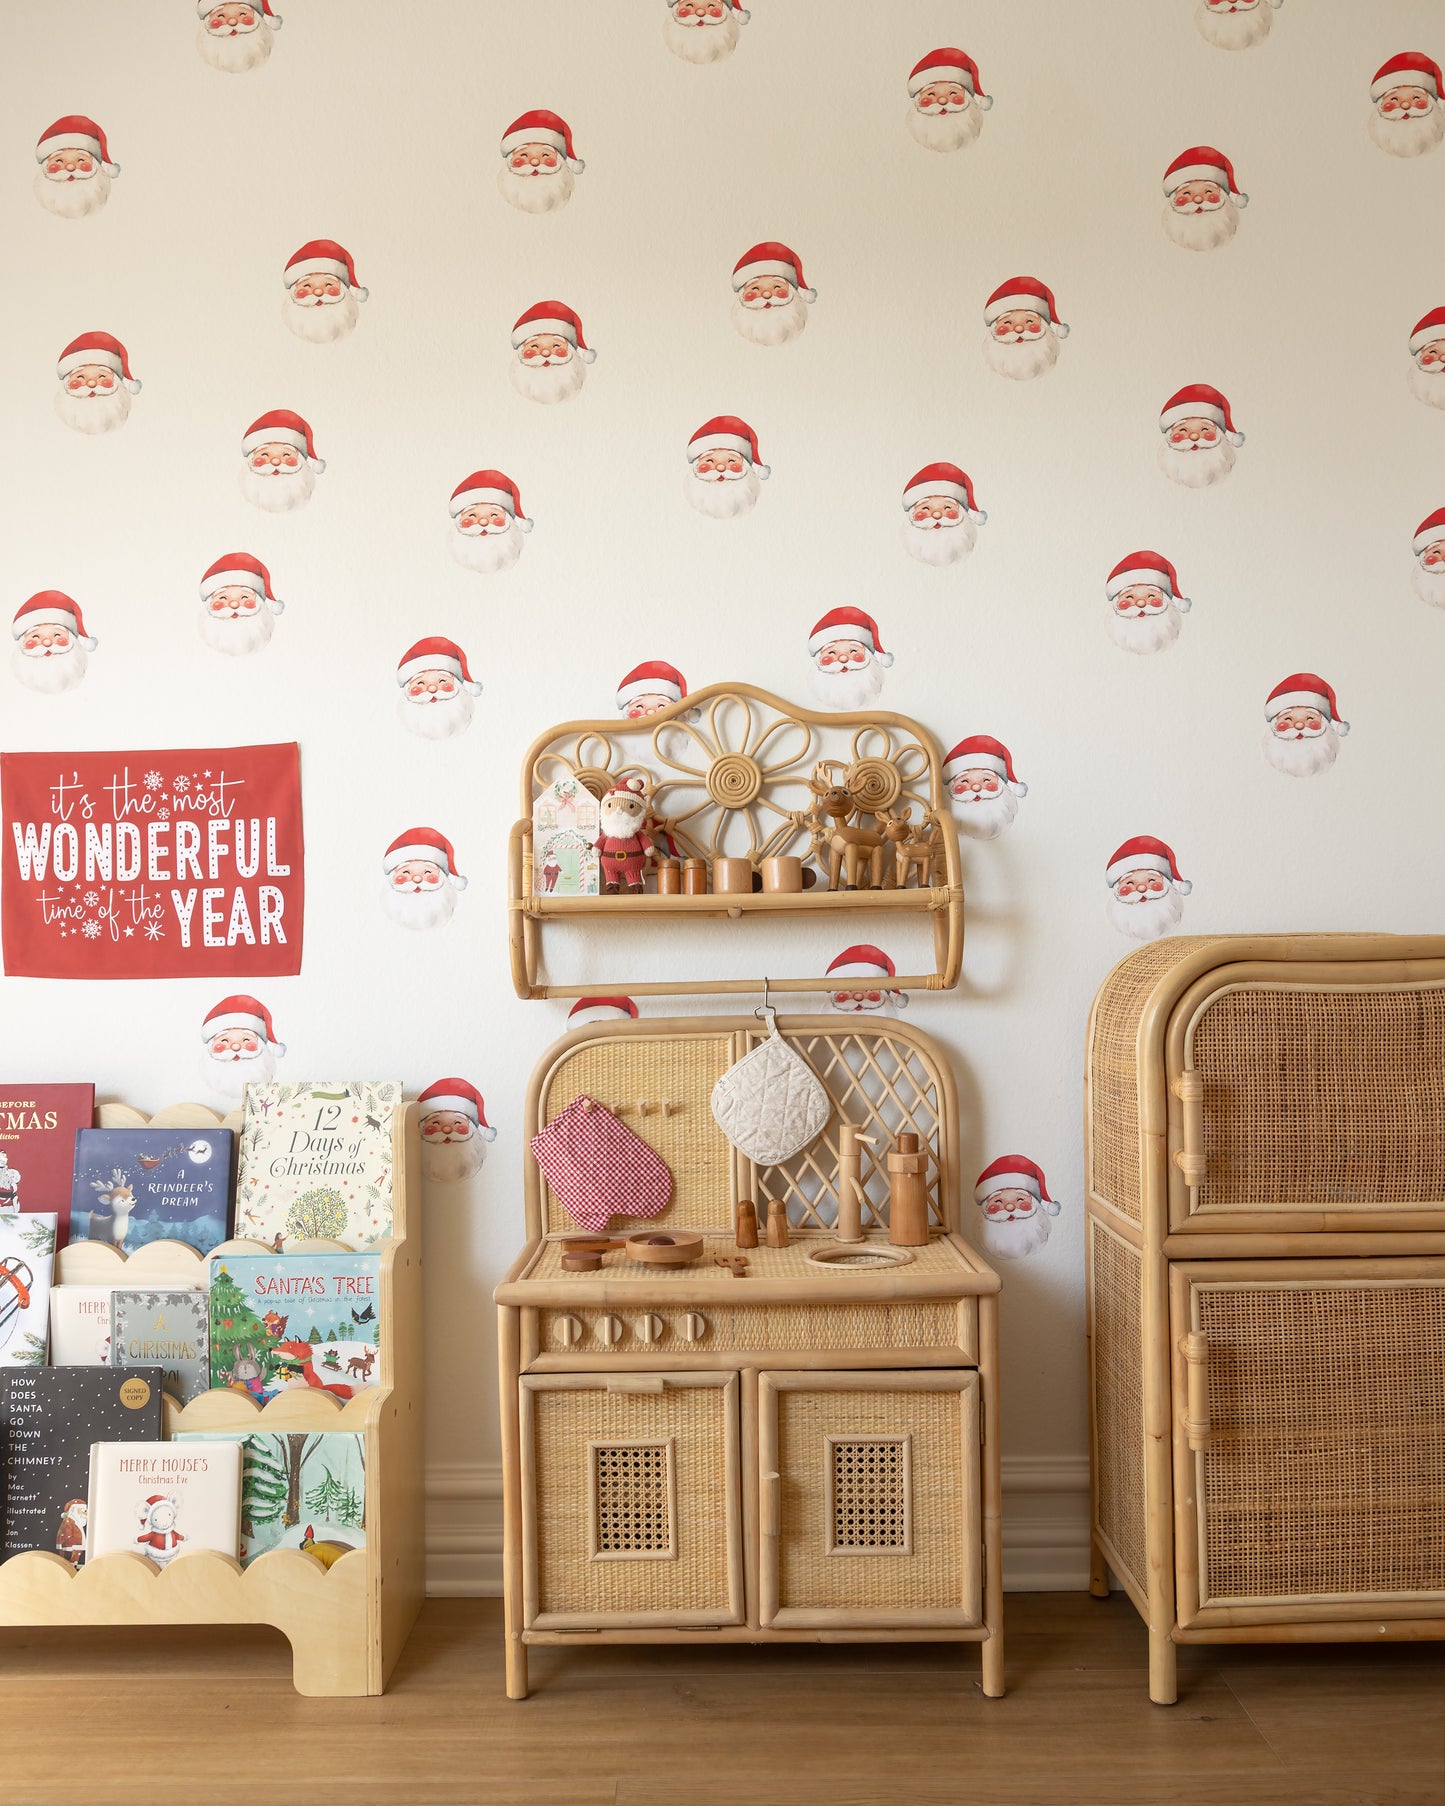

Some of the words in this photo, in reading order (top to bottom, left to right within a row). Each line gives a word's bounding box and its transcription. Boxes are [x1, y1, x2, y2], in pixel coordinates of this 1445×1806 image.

[50, 771, 96, 821] it's
[103, 766, 156, 821] the
[173, 771, 245, 818] most
[12, 817, 291, 882] WONDERFUL
[36, 889, 86, 924] time
[98, 888, 120, 942] of
[124, 884, 165, 924] the
[171, 886, 287, 947] YEAR
[0, 1101, 36, 1109] EFORE
[313, 1105, 342, 1131] 12
[288, 1130, 344, 1160] Days
[348, 1137, 366, 1159] of
[269, 1156, 366, 1178] Christmas
[177, 1169, 185, 1179] A
[148, 1180, 214, 1194] REINDEER'S
[161, 1197, 199, 1207] DREAM
[254, 1275, 326, 1295] SANTA'S
[332, 1276, 375, 1295] TREE
[152, 1312, 169, 1331] A
[129, 1340, 197, 1360] CHRISTMAS
[11, 1378, 36, 1387] HOW
[10, 1391, 37, 1400] DOES
[10, 1404, 43, 1413] SANTA
[9, 1417, 24, 1426] GO
[9, 1430, 41, 1438] DOWN
[9, 1443, 28, 1452] THE
[7, 1456, 63, 1466] CHIMNEY?
[119, 1459, 157, 1472] MERRY
[162, 1458, 209, 1472] MOUSE'S
[8, 1473, 17, 1481] by
[138, 1475, 174, 1484] Christmas
[176, 1475, 188, 1484] Eve
[6, 1518, 15, 1526] by
